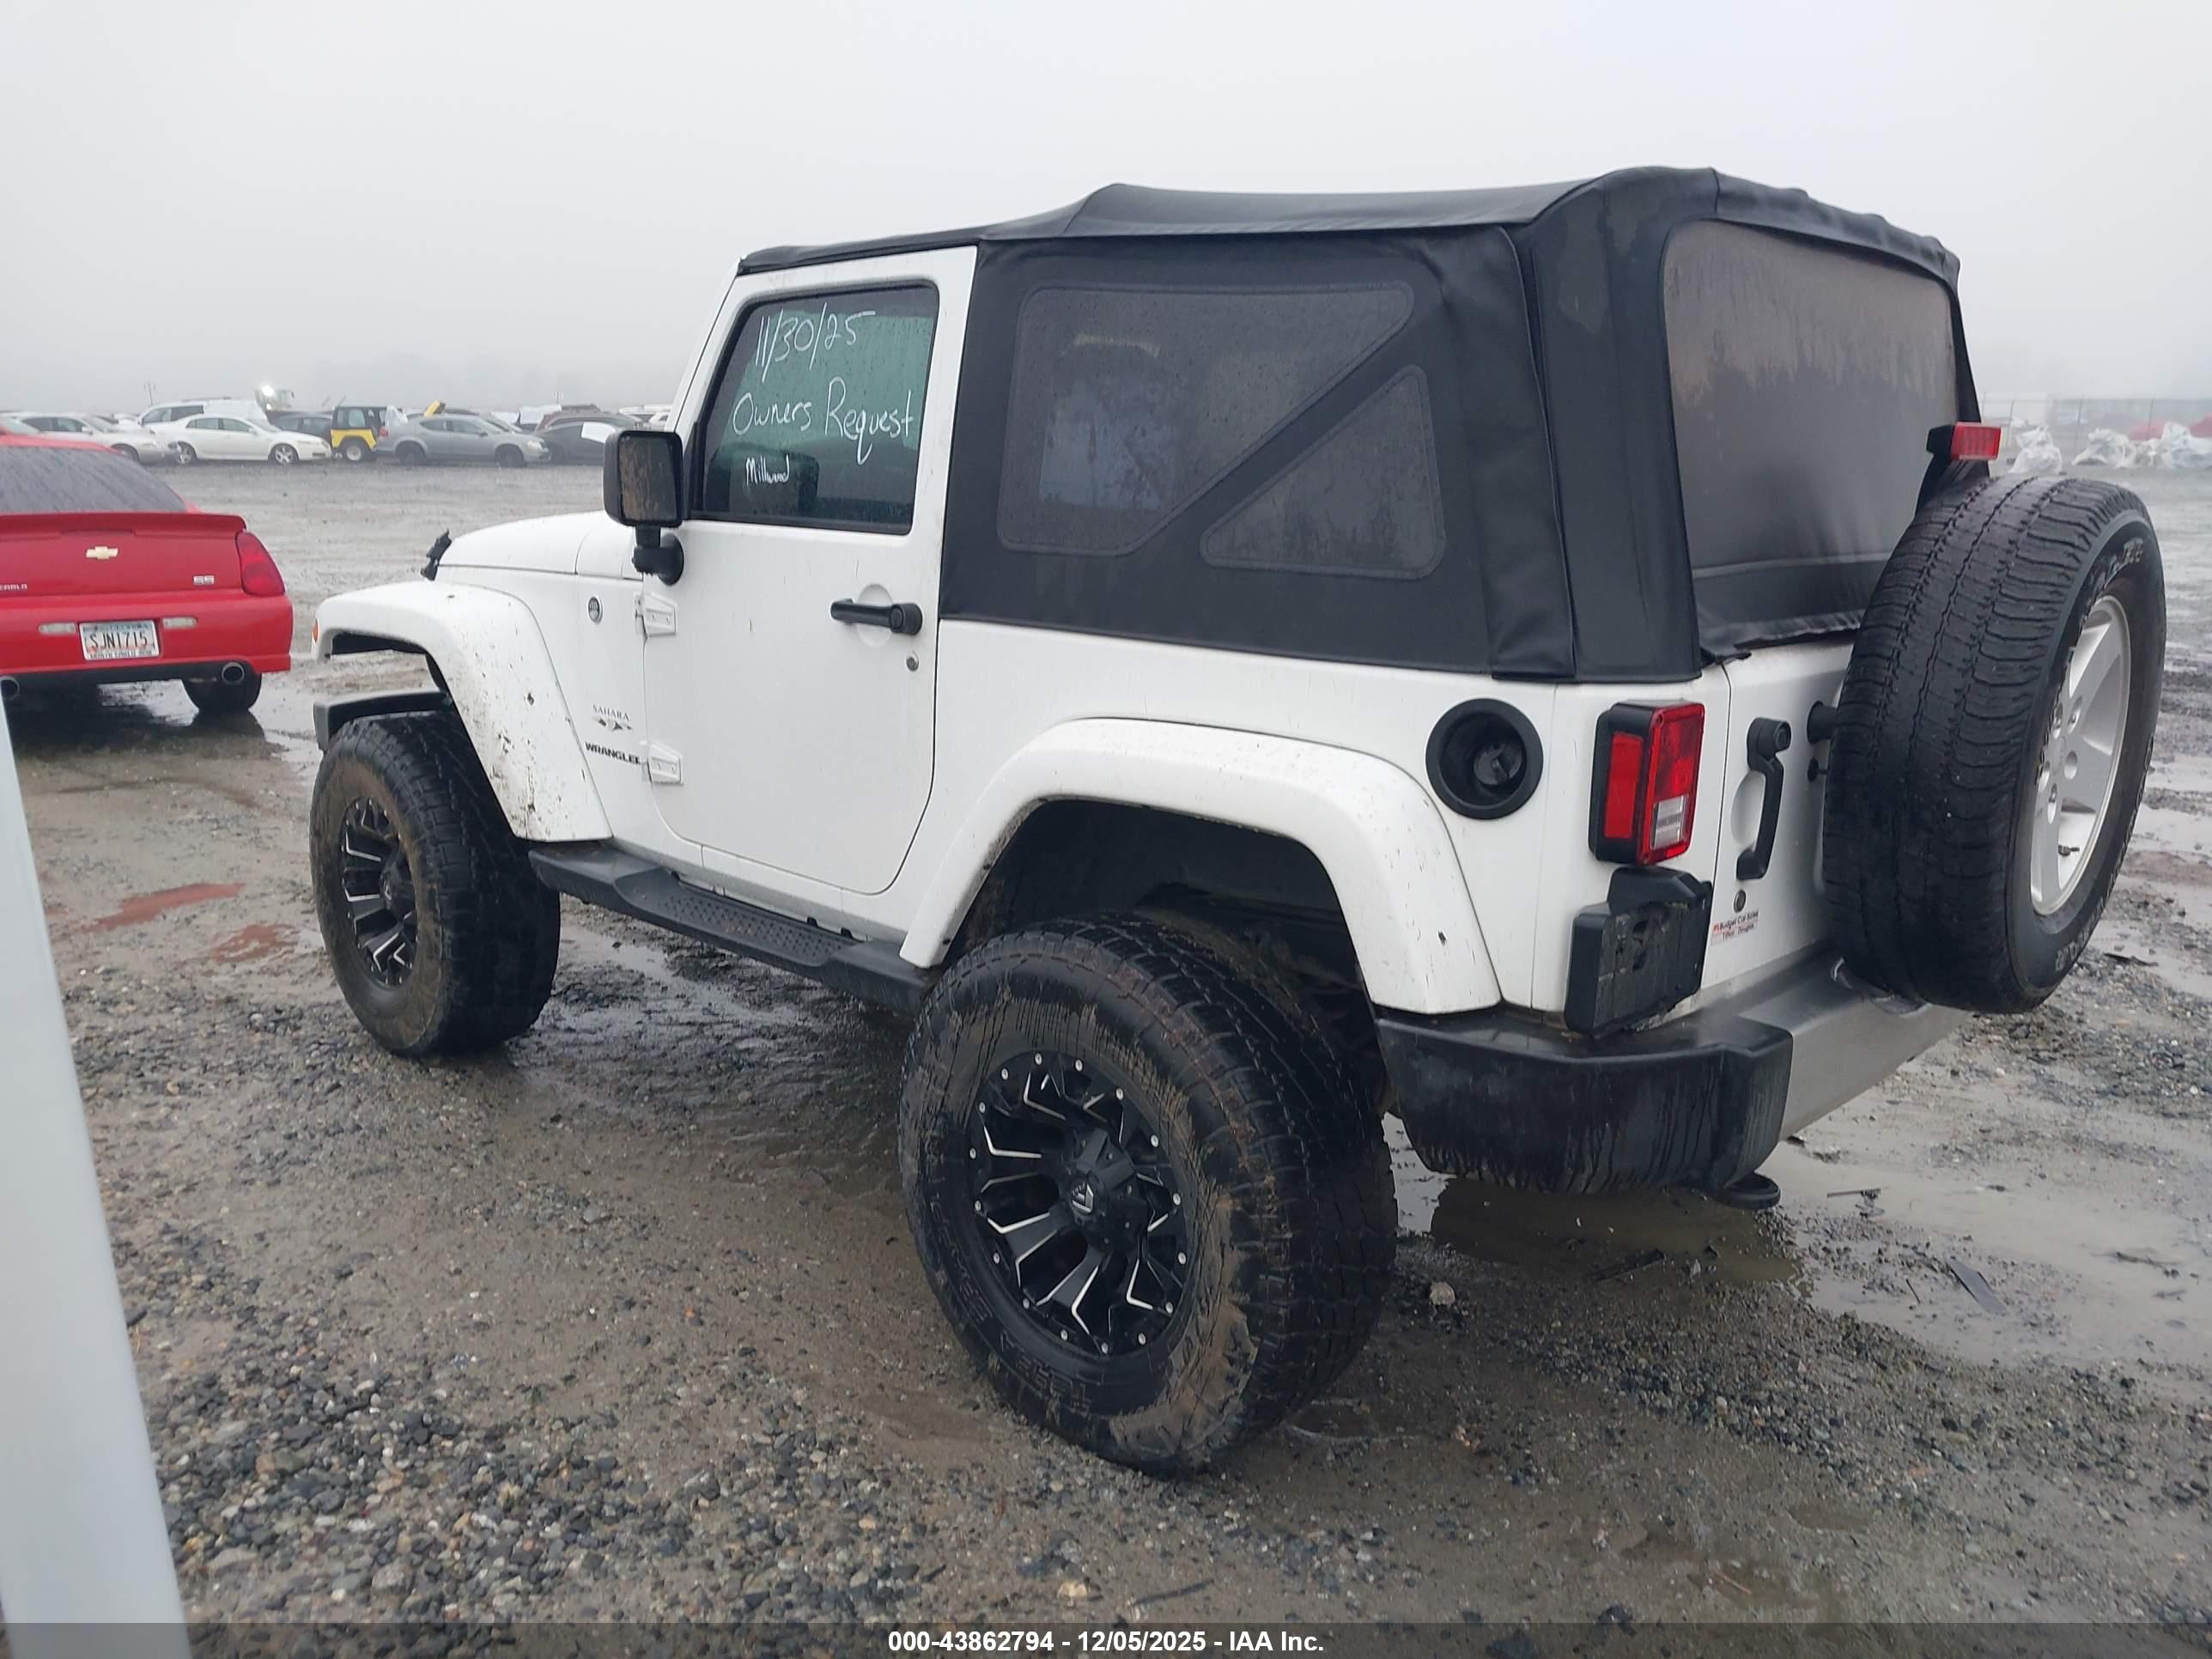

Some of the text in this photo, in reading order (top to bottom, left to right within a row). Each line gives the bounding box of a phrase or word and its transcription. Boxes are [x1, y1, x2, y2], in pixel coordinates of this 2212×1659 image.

[755, 301, 876, 383] 11/30/25
[732, 376, 915, 465] Owners Request
[89, 631, 149, 650] SJN1715
